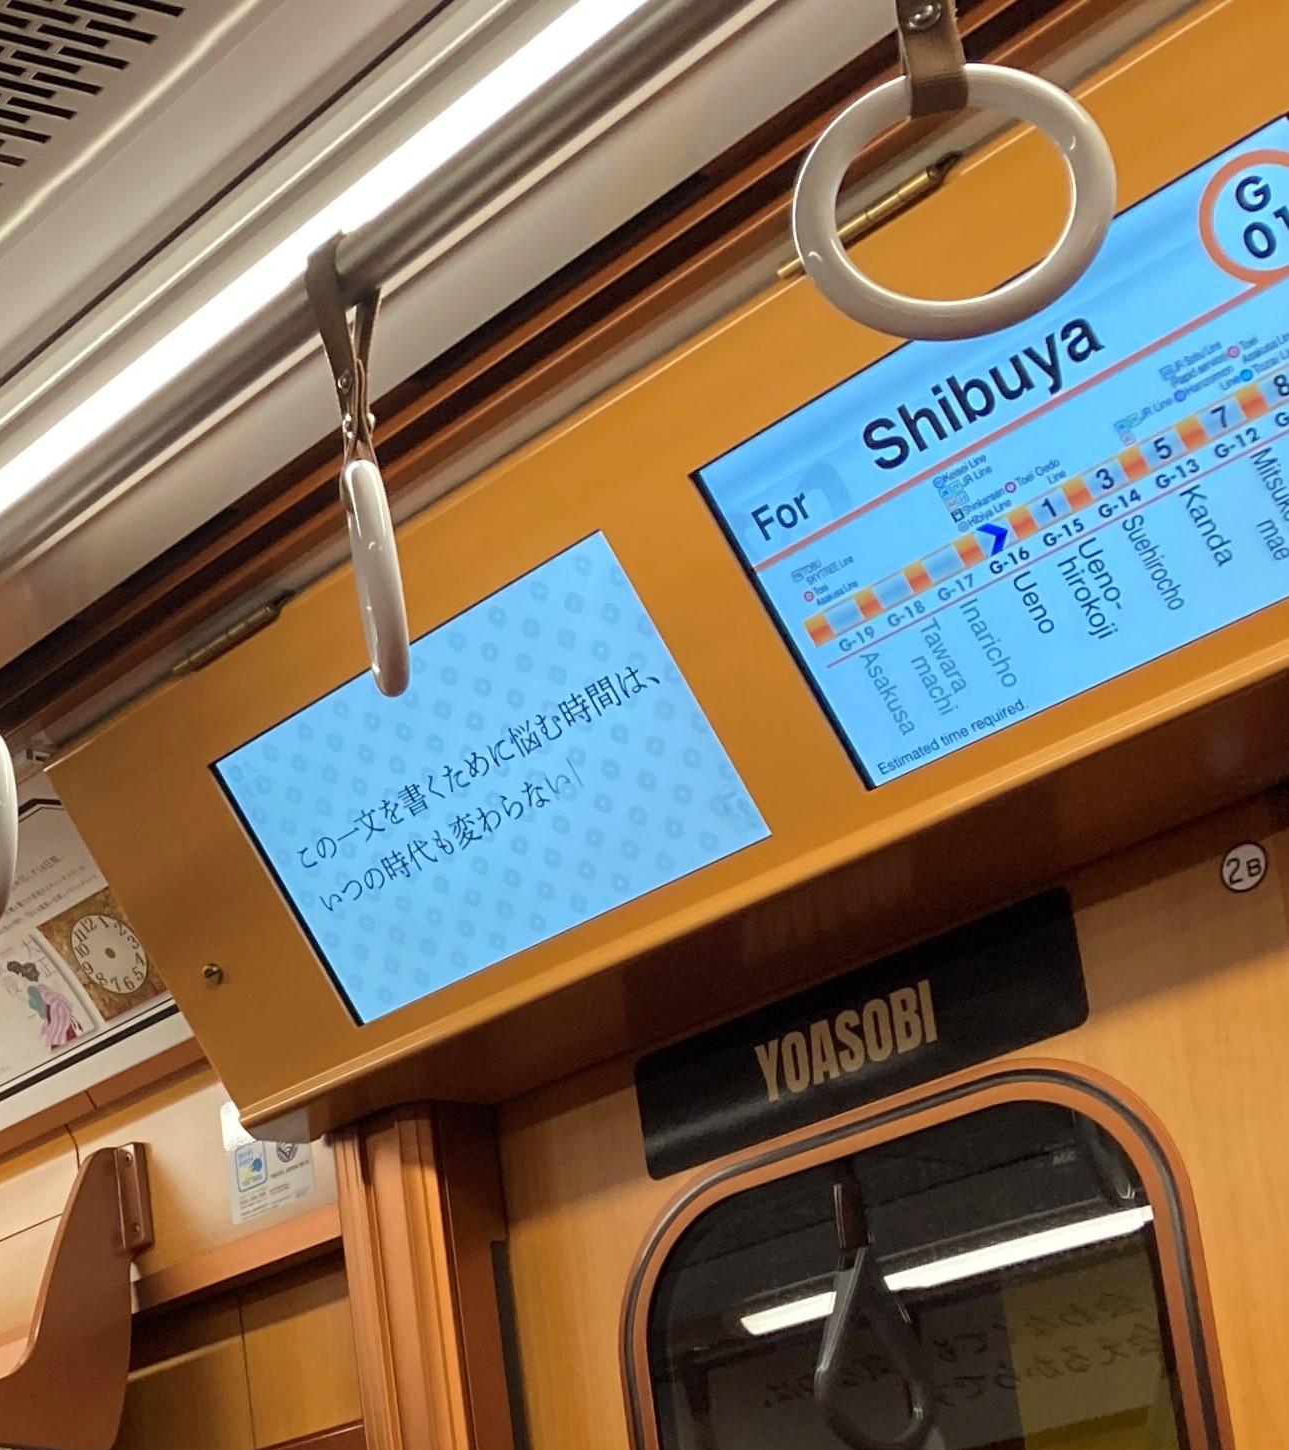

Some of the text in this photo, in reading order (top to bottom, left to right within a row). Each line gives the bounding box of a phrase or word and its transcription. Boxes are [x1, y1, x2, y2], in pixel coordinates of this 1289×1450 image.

[1235, 175, 1271, 212] G
[751, 314, 1105, 541] For Shibuya
[1041, 498, 1057, 518] 1
[1096, 468, 1115, 489] 3
[1153, 437, 1172, 460] 5
[1210, 405, 1228, 429] 7
[839, 626, 875, 653] G-19
[887, 601, 926, 628] G-18
[937, 573, 975, 602] G-17
[989, 547, 1030, 574] G-16
[1043, 518, 1084, 547] G-15
[1098, 489, 1142, 518] G-14
[1155, 458, 1200, 489] G-13
[1213, 427, 1261, 459] G-12
[1122, 514, 1185, 611] Suehirocho
[1179, 484, 1234, 567] Kanda
[1013, 570, 1055, 636] Ueno
[1057, 556, 1119, 640] hirokoji
[1078, 537, 1123, 610] Ueno-
[920, 616, 967, 694] Tawara
[959, 597, 1018, 689] Inaricho
[859, 651, 915, 737] Asakusa
[910, 655, 959, 716] machi
[297, 666, 661, 870] この一文を書くために悩む時間は、
[878, 698, 1029, 775] Estimated time required.
[1226, 857, 1263, 886] 2B
[74, 916, 127, 942] 11 12 1 2
[74, 935, 140, 958] 10 3
[82, 952, 145, 975] 9 4
[95, 967, 144, 992] 8 7 6 5
[755, 980, 938, 1101] YOASOBI
